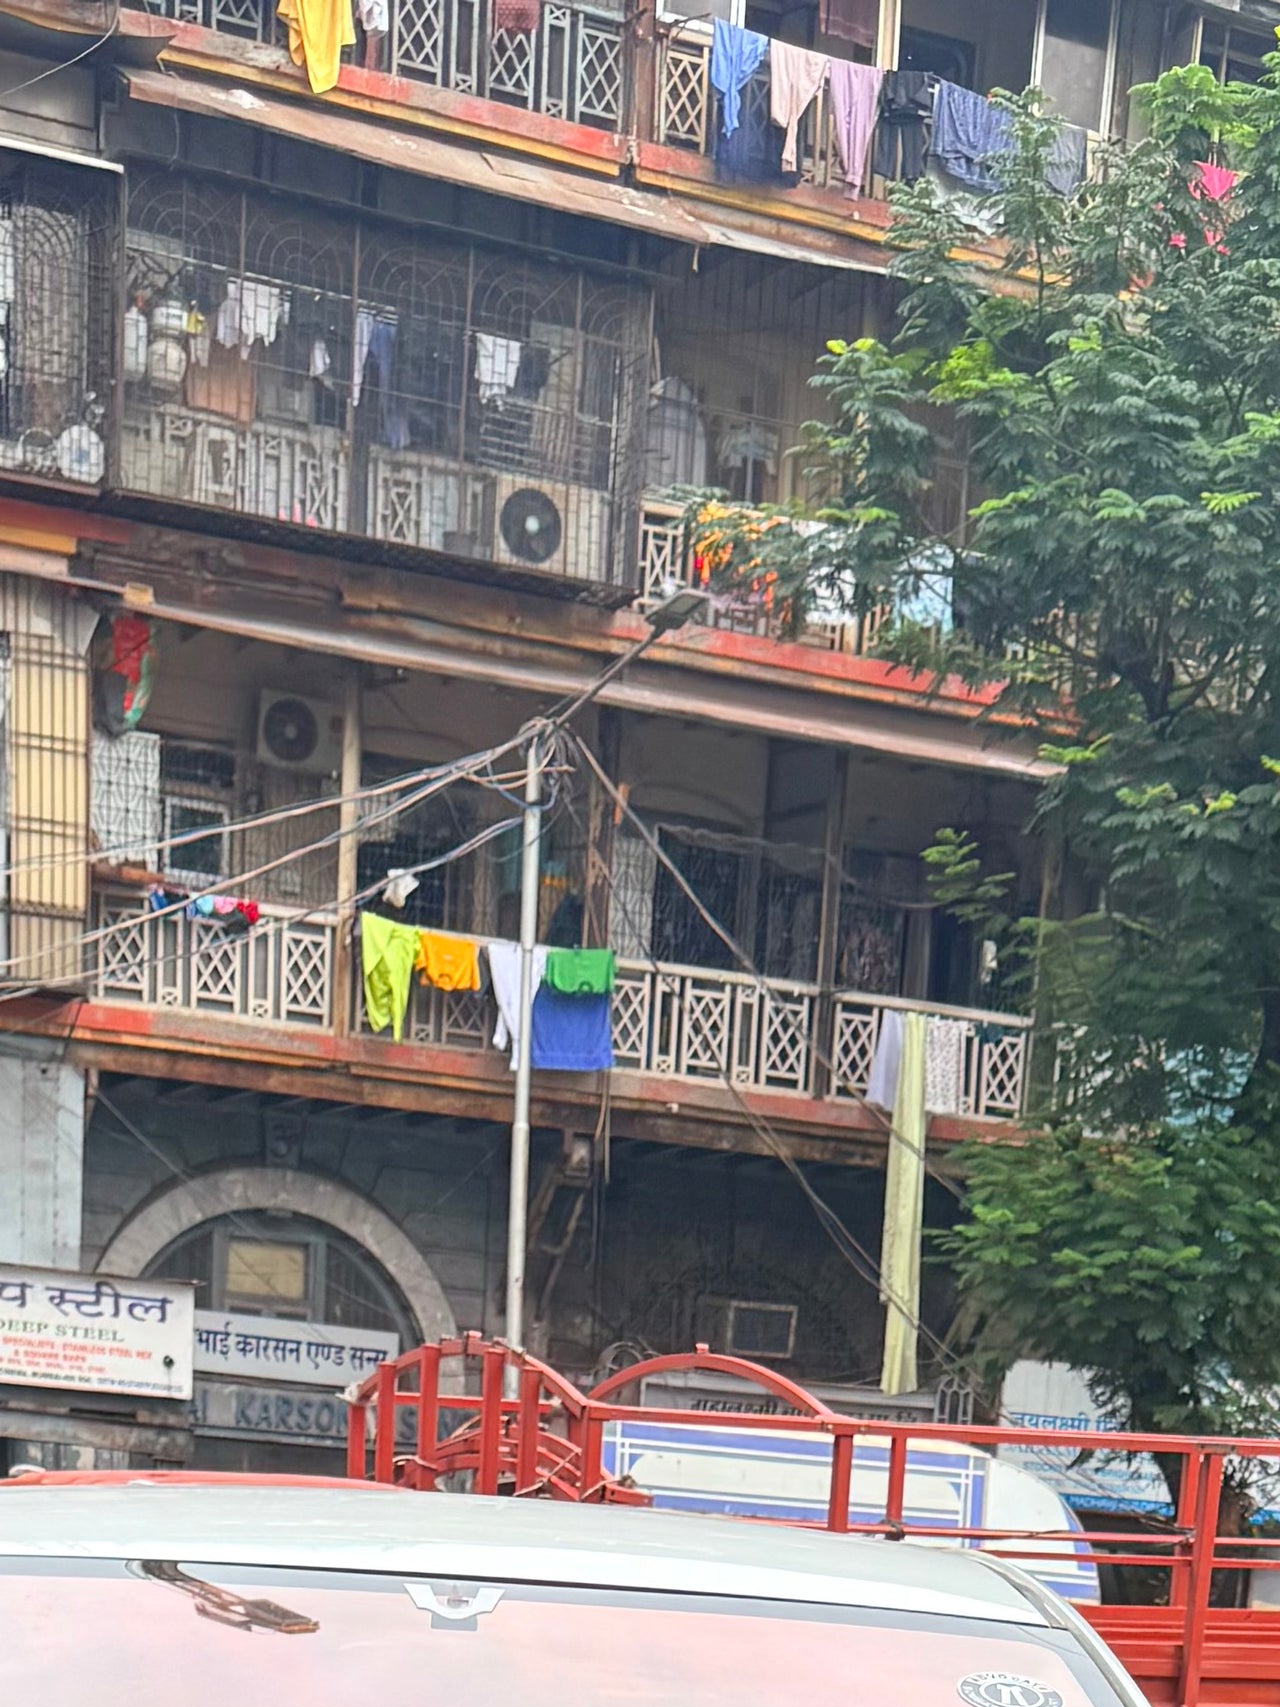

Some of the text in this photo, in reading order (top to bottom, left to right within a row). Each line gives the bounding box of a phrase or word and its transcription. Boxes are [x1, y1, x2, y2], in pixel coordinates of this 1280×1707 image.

[45, 1281, 173, 1323] स्टील
[54, 1325, 125, 1343] STEEL
[235, 1333, 302, 1363] कारसन
